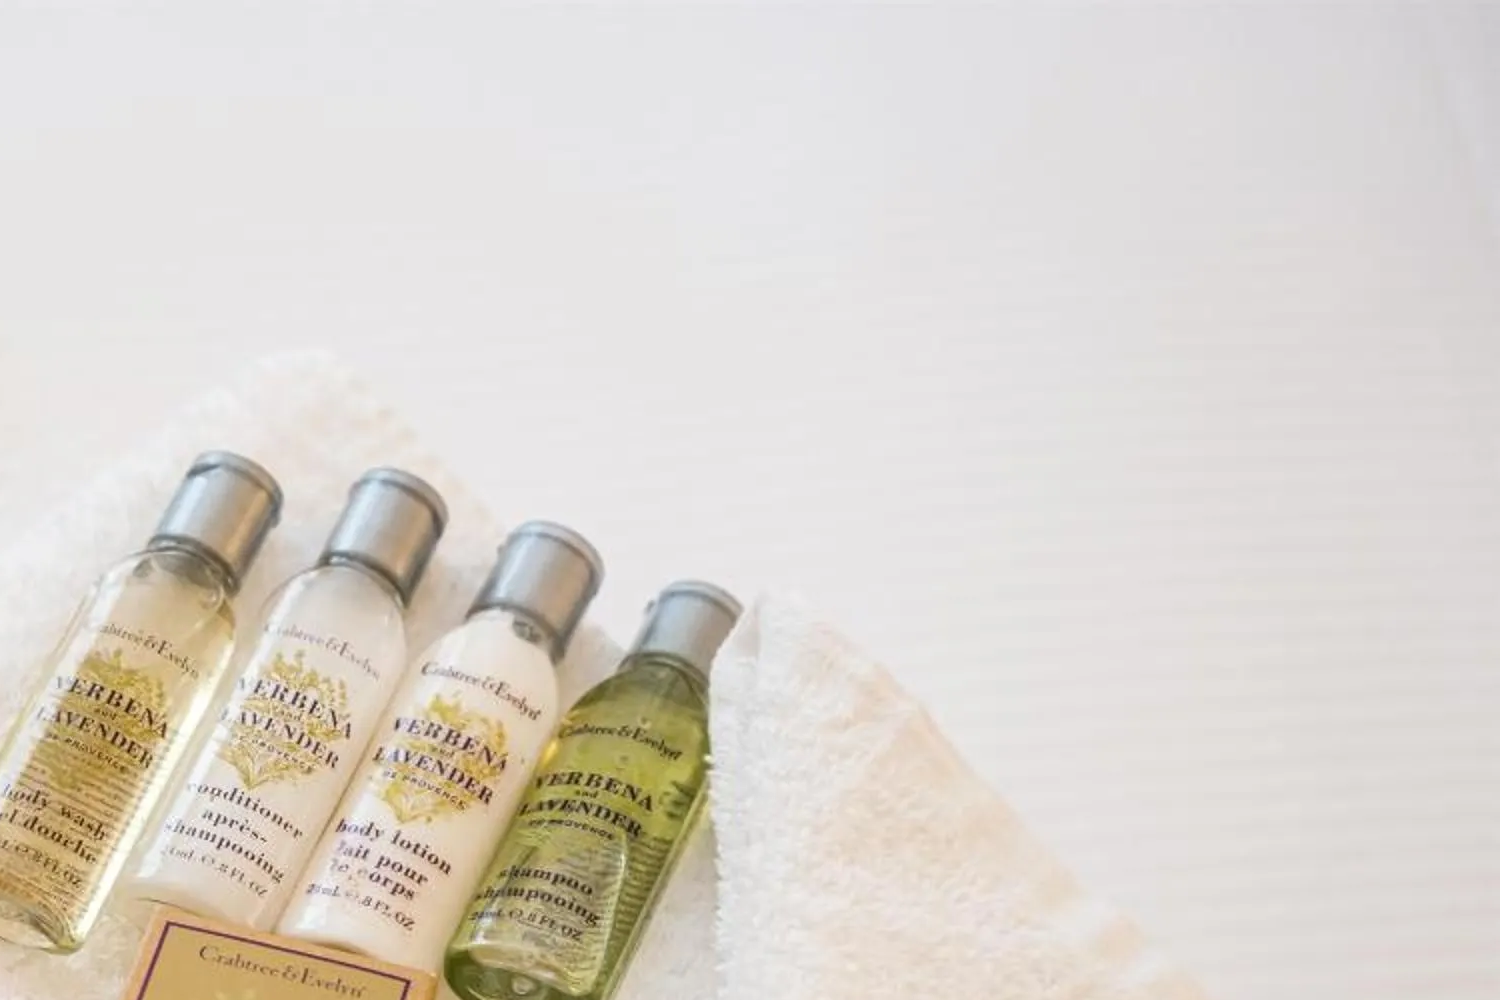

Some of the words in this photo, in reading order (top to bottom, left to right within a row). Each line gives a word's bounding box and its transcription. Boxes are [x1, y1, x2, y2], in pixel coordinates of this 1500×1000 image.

[36, 706, 153, 769] LAVENDER
[220, 707, 340, 769] LAVENDER
[393, 716, 509, 771] VERBENA
[372, 745, 494, 805] LAVENDER
[535, 771, 654, 813] VERBENA
[2, 783, 48, 811] body
[60, 805, 106, 842] wash
[187, 781, 304, 841] conditioner
[518, 798, 643, 839] LAVENDER
[22, 815, 98, 866] douche
[164, 819, 286, 884] shampooing
[335, 817, 384, 842] body
[390, 829, 452, 876] lotion
[336, 839, 371, 860] lait
[374, 854, 429, 887] pour
[330, 857, 350, 873] le
[357, 867, 416, 901] corps
[499, 864, 594, 896] shampoo
